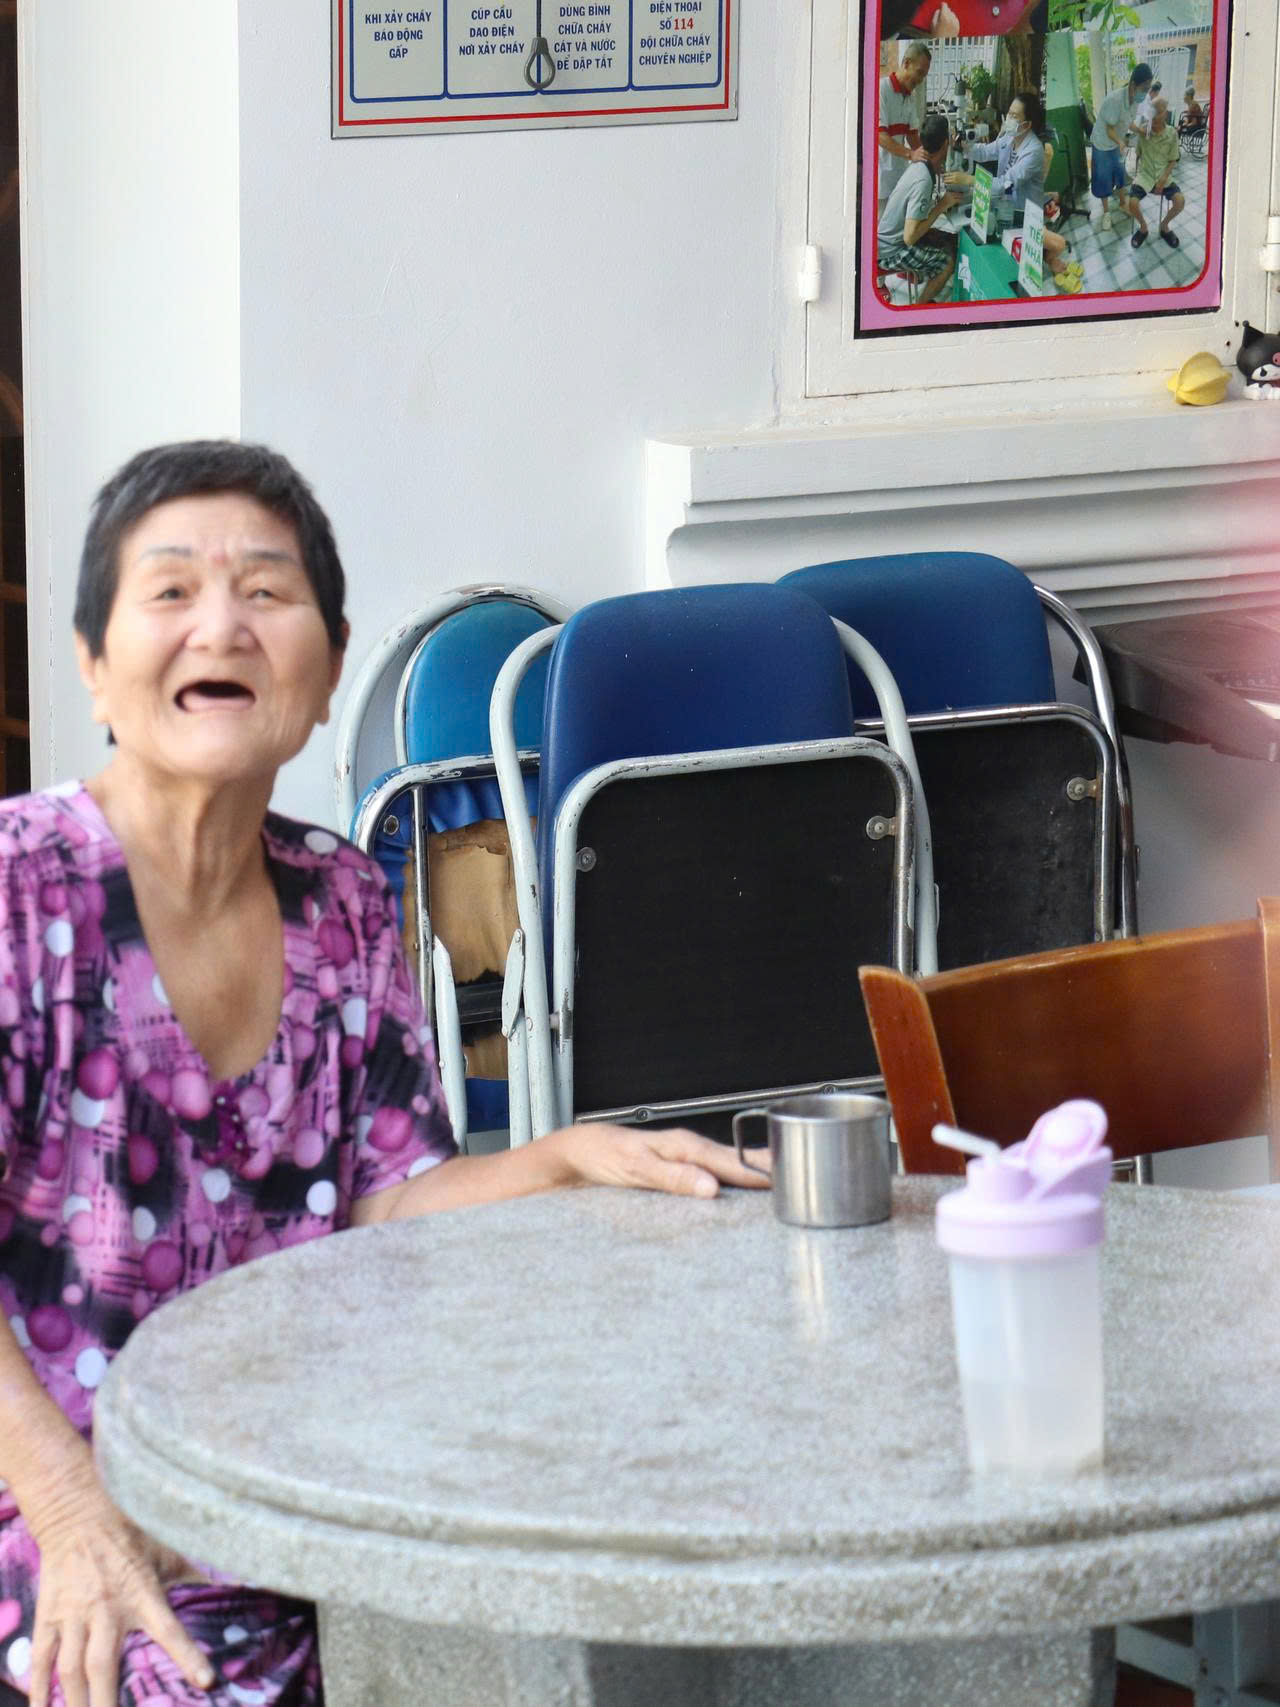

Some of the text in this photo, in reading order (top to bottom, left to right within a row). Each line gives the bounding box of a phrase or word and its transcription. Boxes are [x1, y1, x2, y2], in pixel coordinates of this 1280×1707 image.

[472, 7, 490, 20] CÚP
[560, 3, 610, 17] DÙNG BÌNH
[650, 0, 702, 15] ĐIỆN THOẠI
[365, 14, 382, 24] KHI
[406, 10, 432, 22] CHÁY
[660, 16, 694, 30] SỐ 114
[470, 24, 514, 38] DAO ĐIỆN
[559, 20, 612, 34] CHỮA CHÁY
[374, 28, 423, 42] BÁO ĐỘNG
[640, 33, 710, 50] ĐỘI CHỮA CHÁY
[389, 45, 408, 58] GẤP
[459, 45, 474, 56] NƠI
[499, 41, 524, 54] CHÁY
[554, 38, 616, 53] CÁT VÀ NƯỚC
[557, 55, 571, 70] ĐỂ
[574, 57, 592, 71] DẬP
[639, 51, 711, 65] CHUYÊN NGHIỆP
